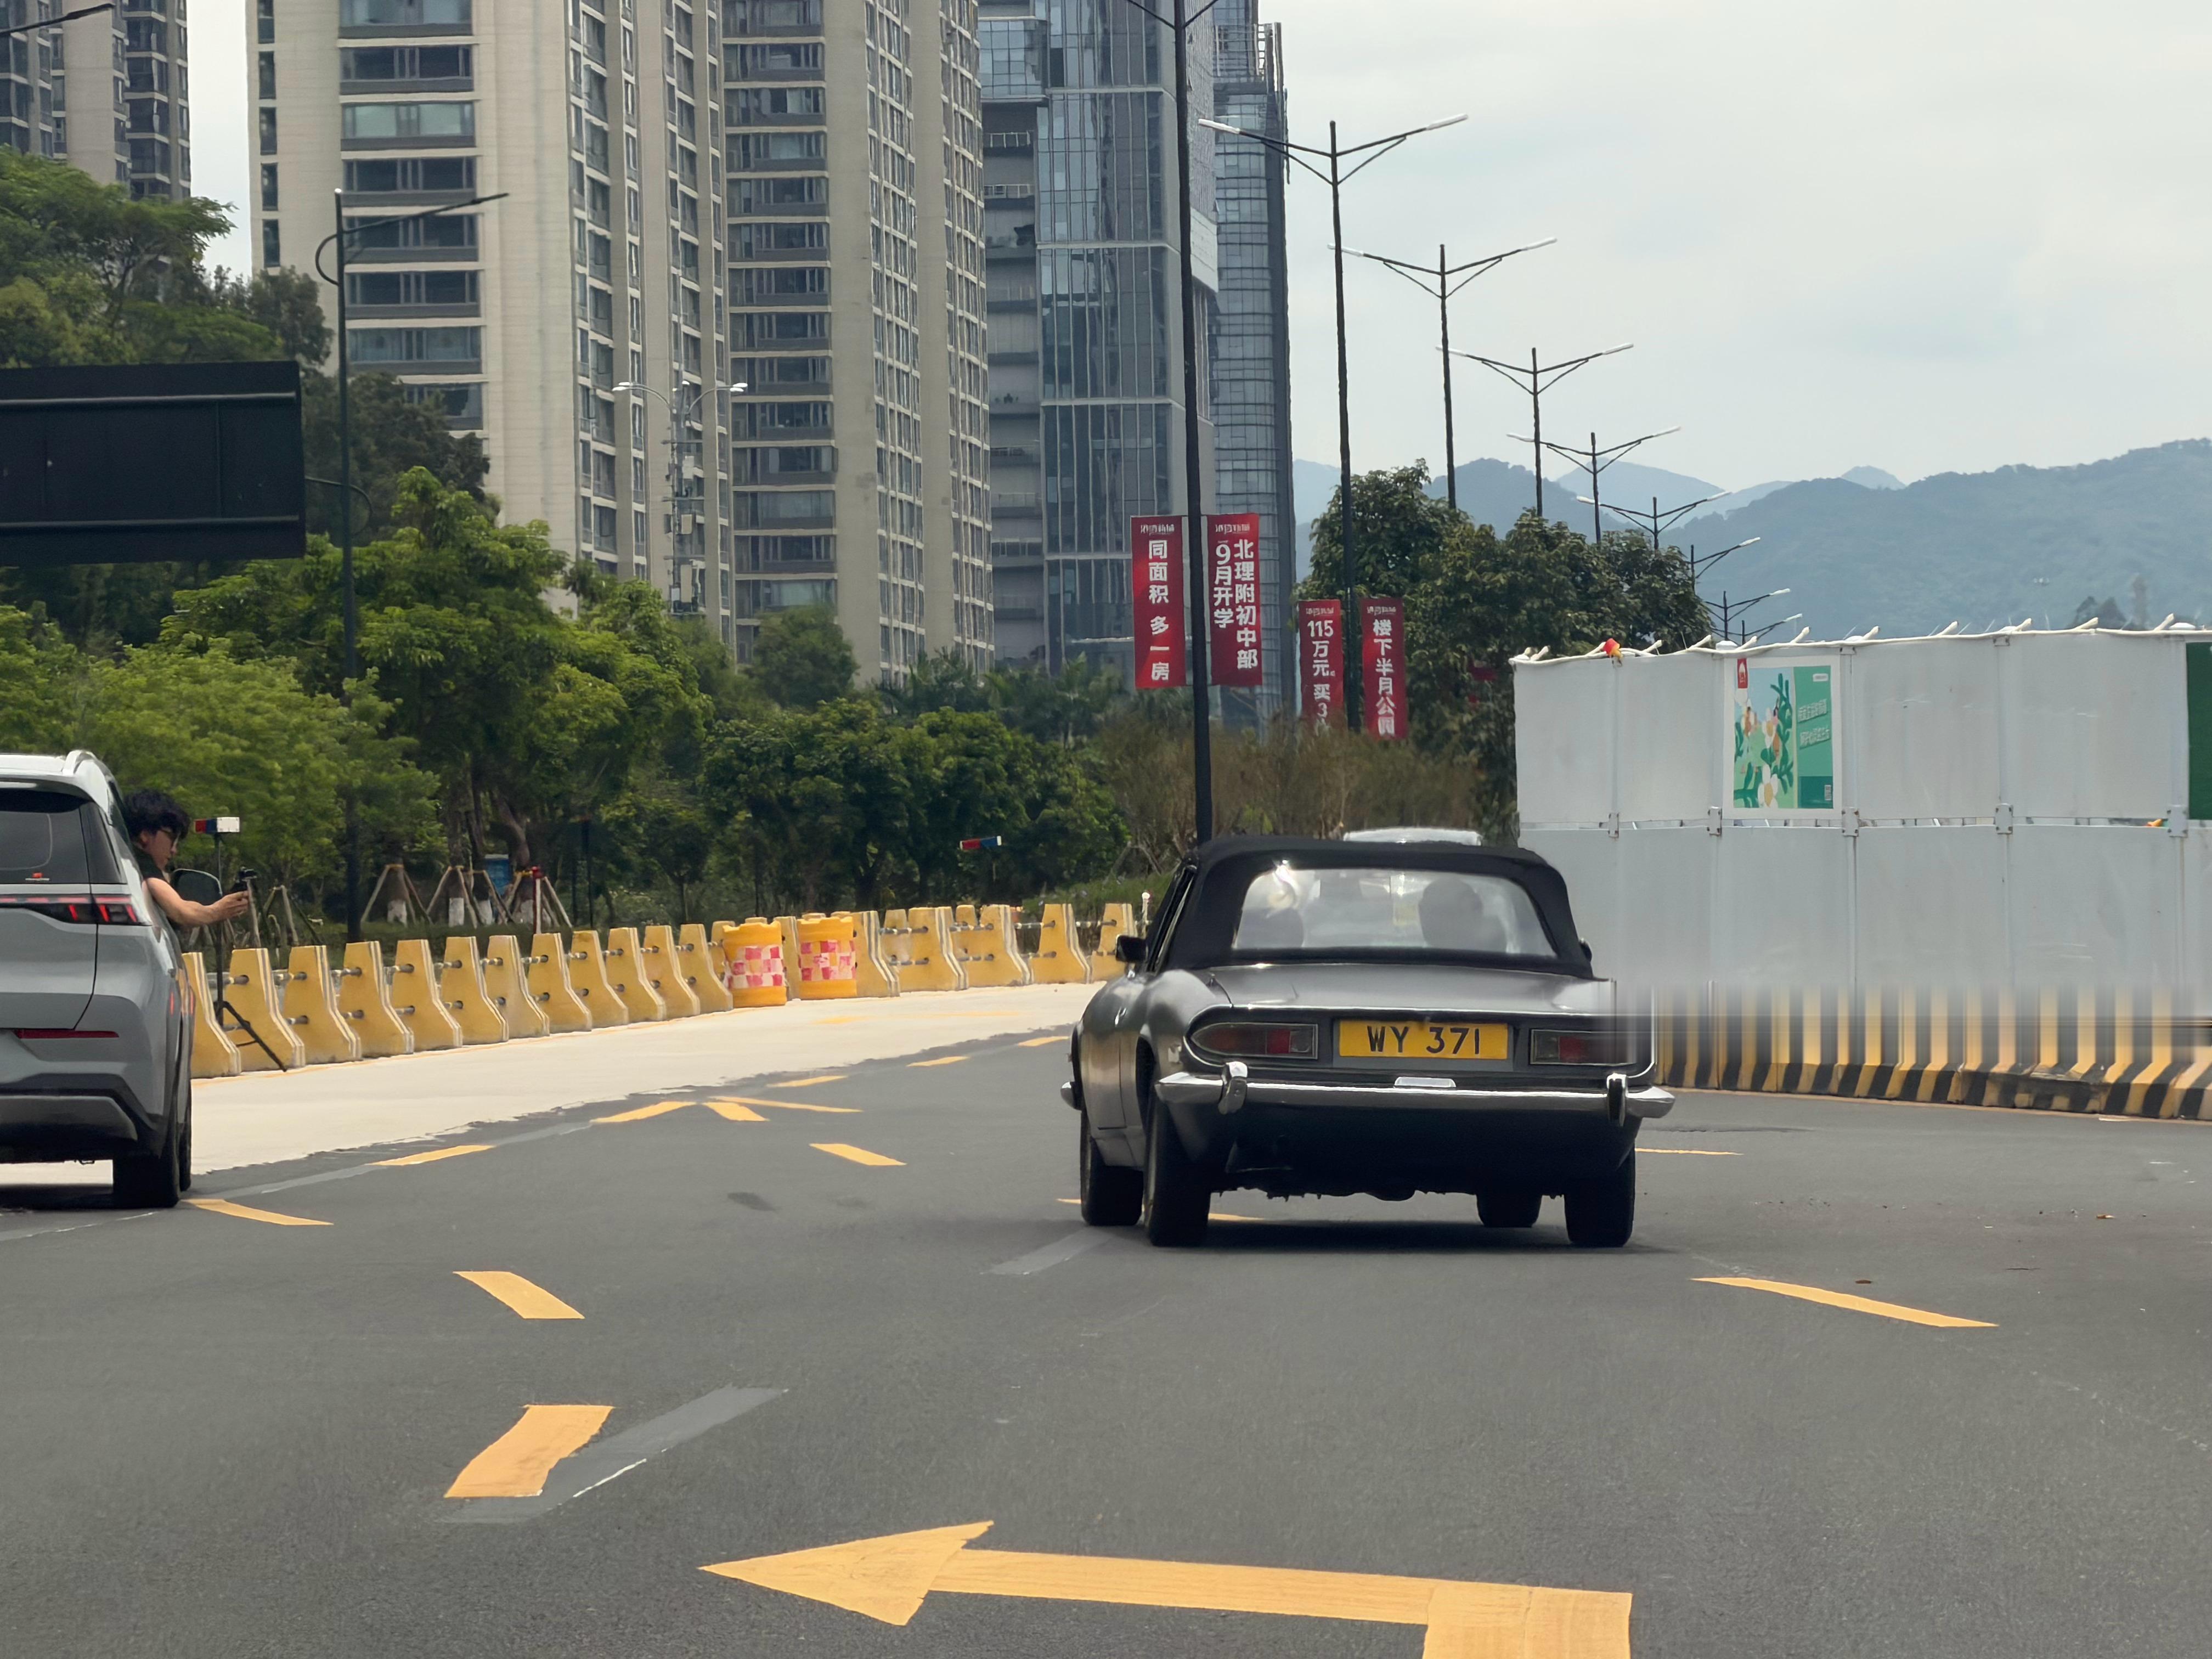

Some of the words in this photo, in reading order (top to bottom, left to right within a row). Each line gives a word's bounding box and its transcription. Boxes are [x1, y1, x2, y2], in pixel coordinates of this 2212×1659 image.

[1148, 540, 1169, 604] 同面积
[1214, 544, 1234, 628] 9月开学
[1234, 539, 1258, 669] 北理附初中部
[1150, 616, 1170, 681] 多一房
[1373, 619, 1396, 736] 楼下半月公园
[1367, 1025, 1409, 1053] WY
[1426, 1026, 1480, 1054] 371
